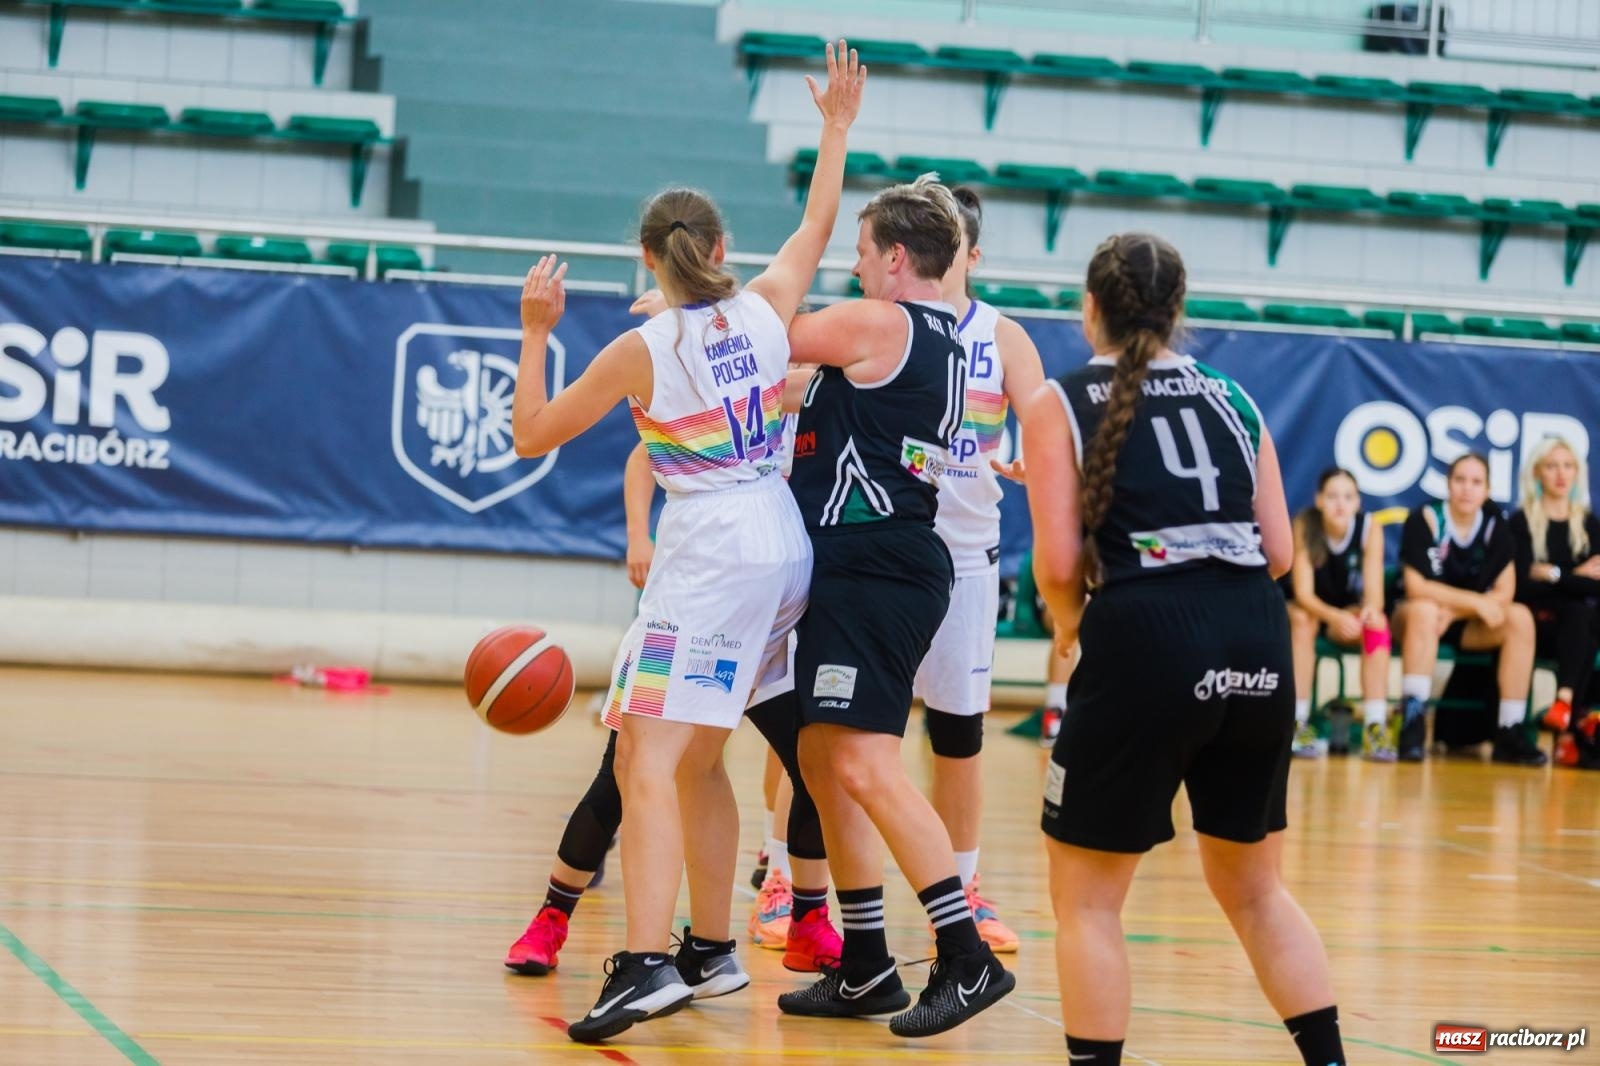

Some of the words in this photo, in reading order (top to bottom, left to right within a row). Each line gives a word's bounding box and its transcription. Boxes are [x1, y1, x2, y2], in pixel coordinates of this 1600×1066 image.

[705, 333, 753, 361] KAMIENICA
[969, 341, 993, 379] 15
[711, 353, 759, 387] POLSKA
[722, 385, 774, 463] 14
[0, 428, 171, 470] RACIBÓRZ
[1151, 408, 1220, 511] 4
[943, 467, 979, 479] ETBALL
